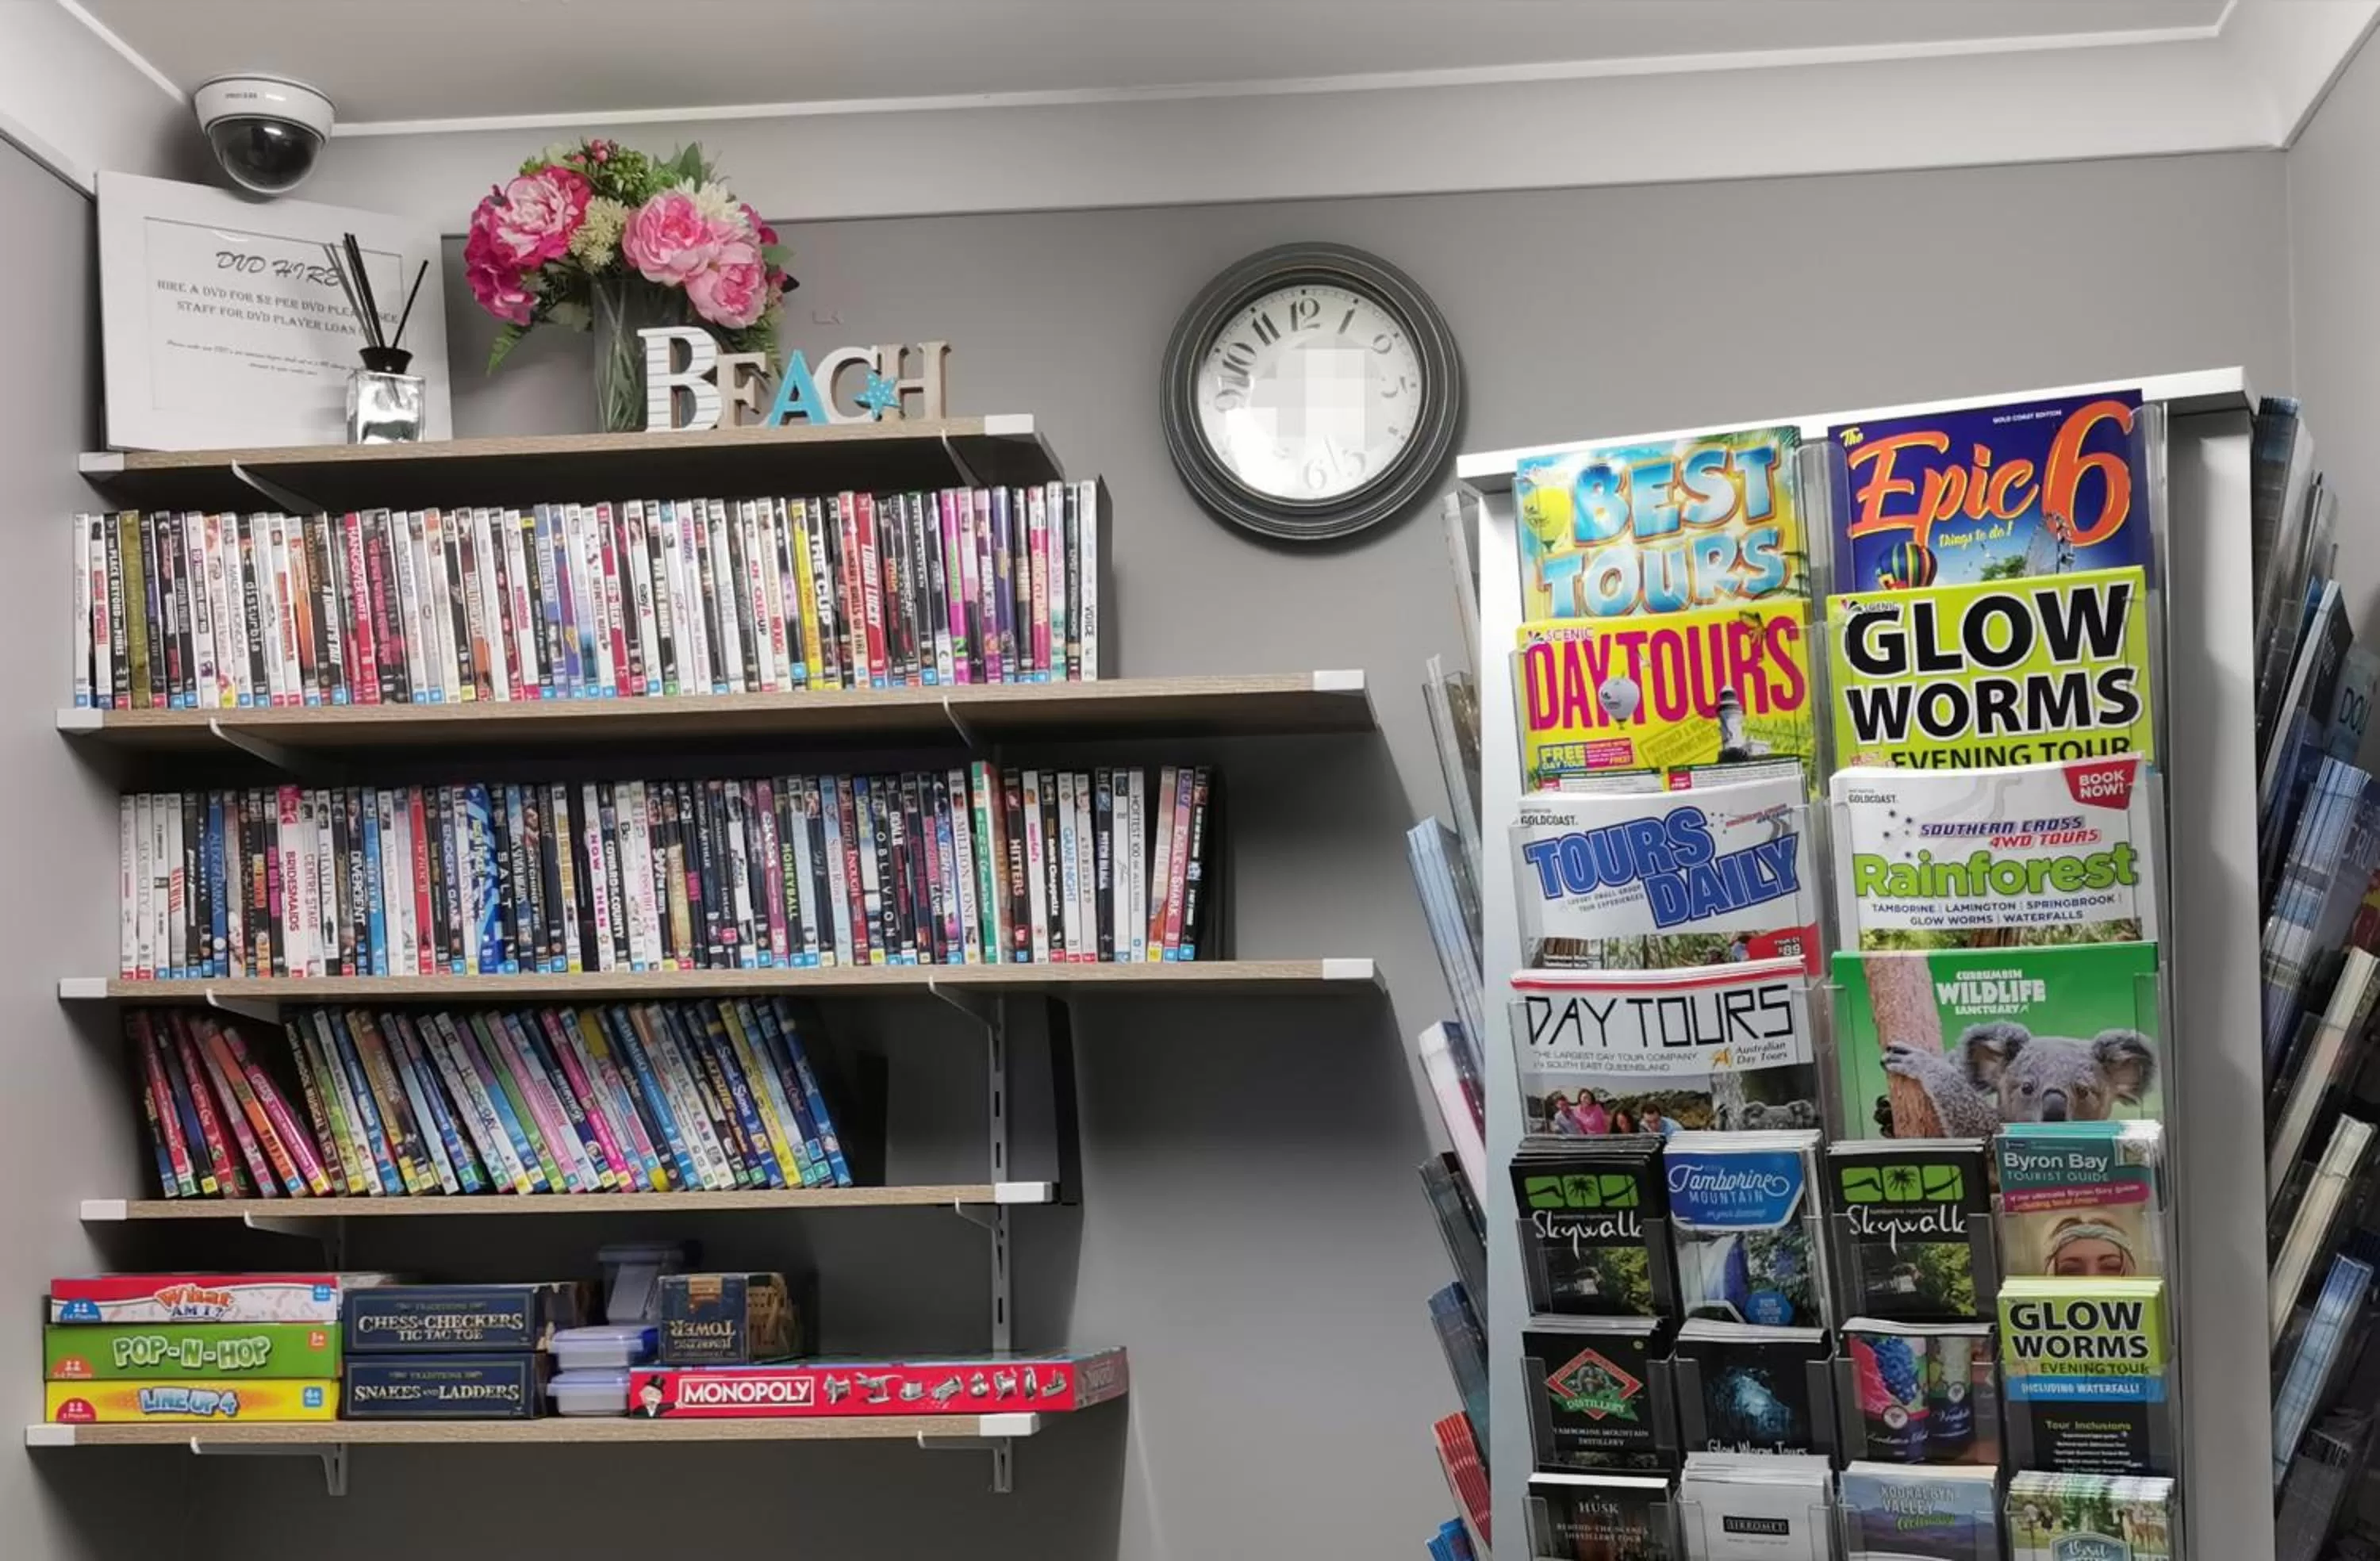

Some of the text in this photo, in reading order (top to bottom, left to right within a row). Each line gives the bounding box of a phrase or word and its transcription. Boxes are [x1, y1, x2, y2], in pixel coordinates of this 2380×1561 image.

[216, 251, 267, 274] DVD
[1289, 297, 1320, 332] 12
[637, 326, 951, 433] BEACH
[1840, 428, 1864, 447] The
[1848, 400, 2134, 548] Epic 6
[1574, 443, 1779, 546] BEST
[811, 534, 832, 624] THE CUP
[1539, 527, 1788, 616] TOURS
[244, 581, 263, 652] disturbia
[1845, 583, 2131, 676] GLOW
[1524, 616, 1805, 731] DAY TOURS
[1847, 667, 2140, 742] WORMS
[1541, 745, 1584, 762] FREE
[1891, 738, 2131, 769] EVENING TOUR
[2079, 769, 2125, 785] BOOK
[2079, 783, 2125, 799] NOW!
[1920, 815, 2084, 837] SOUTHERN CROSS
[1990, 829, 2100, 848] 4WD TOURS
[1008, 838, 1024, 897] HITTERS
[1522, 806, 1715, 899] TOURS
[497, 851, 512, 908] SALT
[782, 843, 798, 920] MONEYBALL
[876, 831, 895, 938] OBLIVION
[1168, 824, 1187, 917] EAGLE SHARK
[1645, 833, 1801, 930] DAILY
[1852, 842, 2138, 898] Rainforest
[286, 851, 299, 932] BRIDESMAIDS
[351, 850, 366, 926] DIVERGENT
[1872, 895, 2115, 914] TAMBORINE LAMINGTON SPRINGBROOK
[1910, 911, 2083, 926] GLOW WORMS WATERFALLS
[1937, 980, 2046, 1005] WILDLIFE
[1526, 984, 1794, 1049] DAY TOURS
[1736, 1043, 1787, 1056] Australian
[1737, 1050, 1788, 1065] Day Tours
[2004, 1152, 2108, 1172] Byron Bay
[2007, 1170, 2110, 1182] TOURIST GUIDE
[1668, 1164, 1791, 1197] Tamborine
[1689, 1191, 1764, 1205] MOUNTAIN
[1532, 1210, 1644, 1260] Skywalk
[1847, 1204, 1967, 1256] Skywalk
[359, 1314, 524, 1333] CHESS CHECKERS
[2010, 1302, 2141, 1331] GLOW
[397, 1329, 423, 1341] TIC
[2012, 1335, 2149, 1359] WORMS
[113, 1336, 272, 1371] POP-N-HOP
[2040, 1363, 2105, 1375] EVENING
[355, 1385, 520, 1401] SNAKES LADDERS
[684, 1381, 810, 1403] MONOPOLY
[2021, 1383, 2075, 1394] INCLUDING
[1566, 1398, 1626, 1413] DISTILLERY
